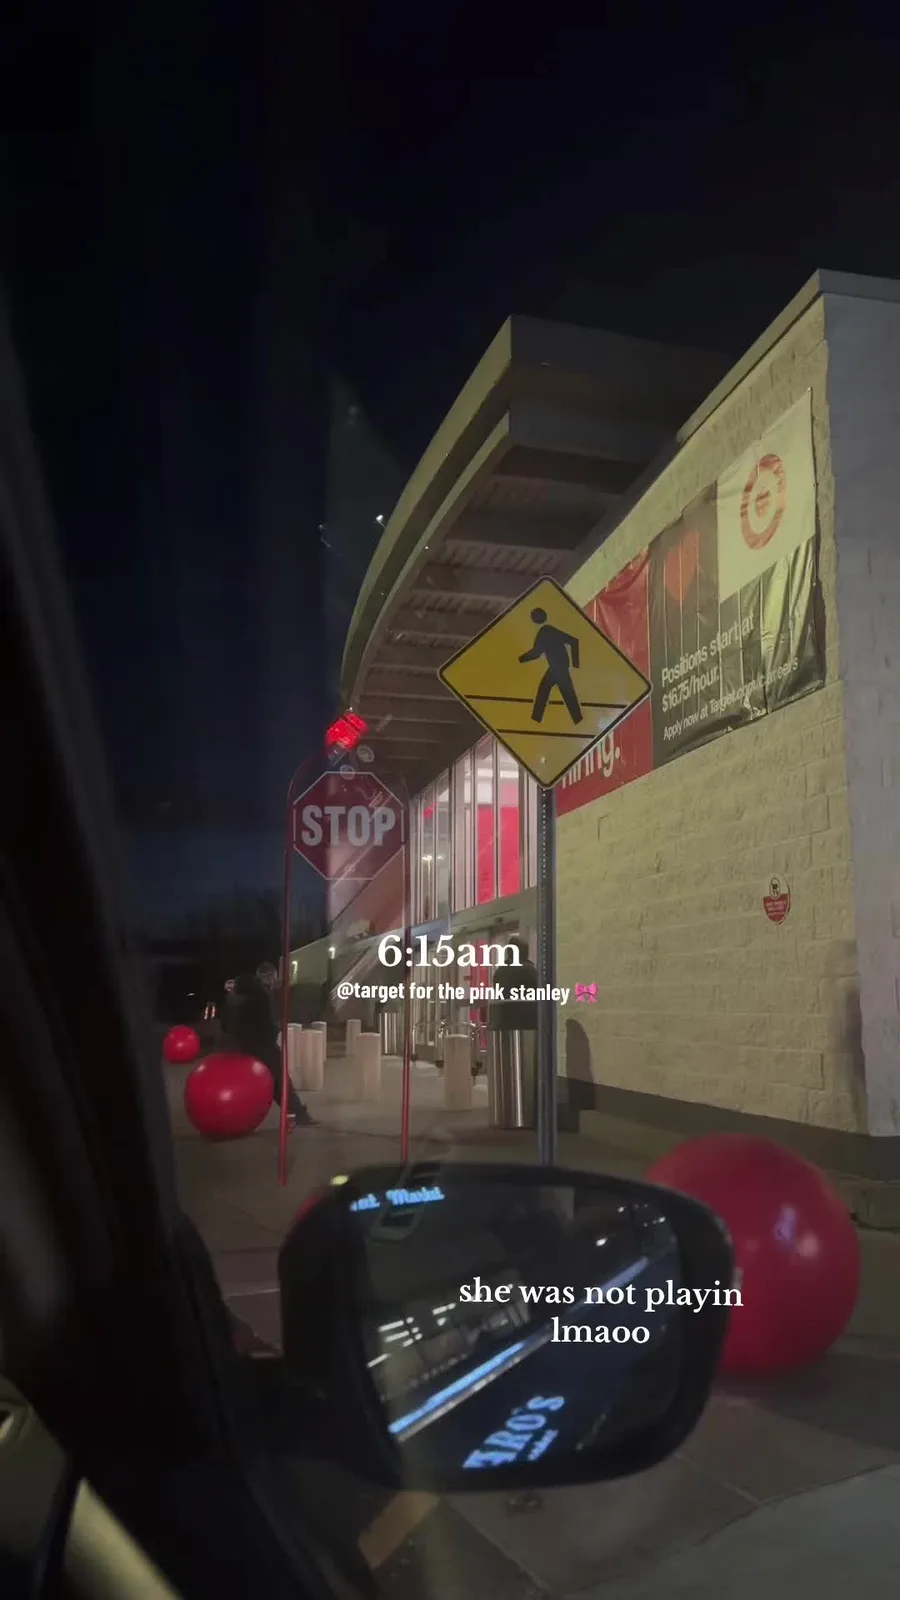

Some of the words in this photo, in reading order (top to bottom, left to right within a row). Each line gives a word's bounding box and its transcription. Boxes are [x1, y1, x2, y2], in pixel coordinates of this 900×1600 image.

[661, 645, 709, 688] Positions
[709, 620, 740, 657] start
[740, 614, 755, 637] at
[663, 719, 684, 741] Apply
[683, 711, 700, 730] now
[699, 705, 709, 720] at
[301, 804, 396, 847] STOP
